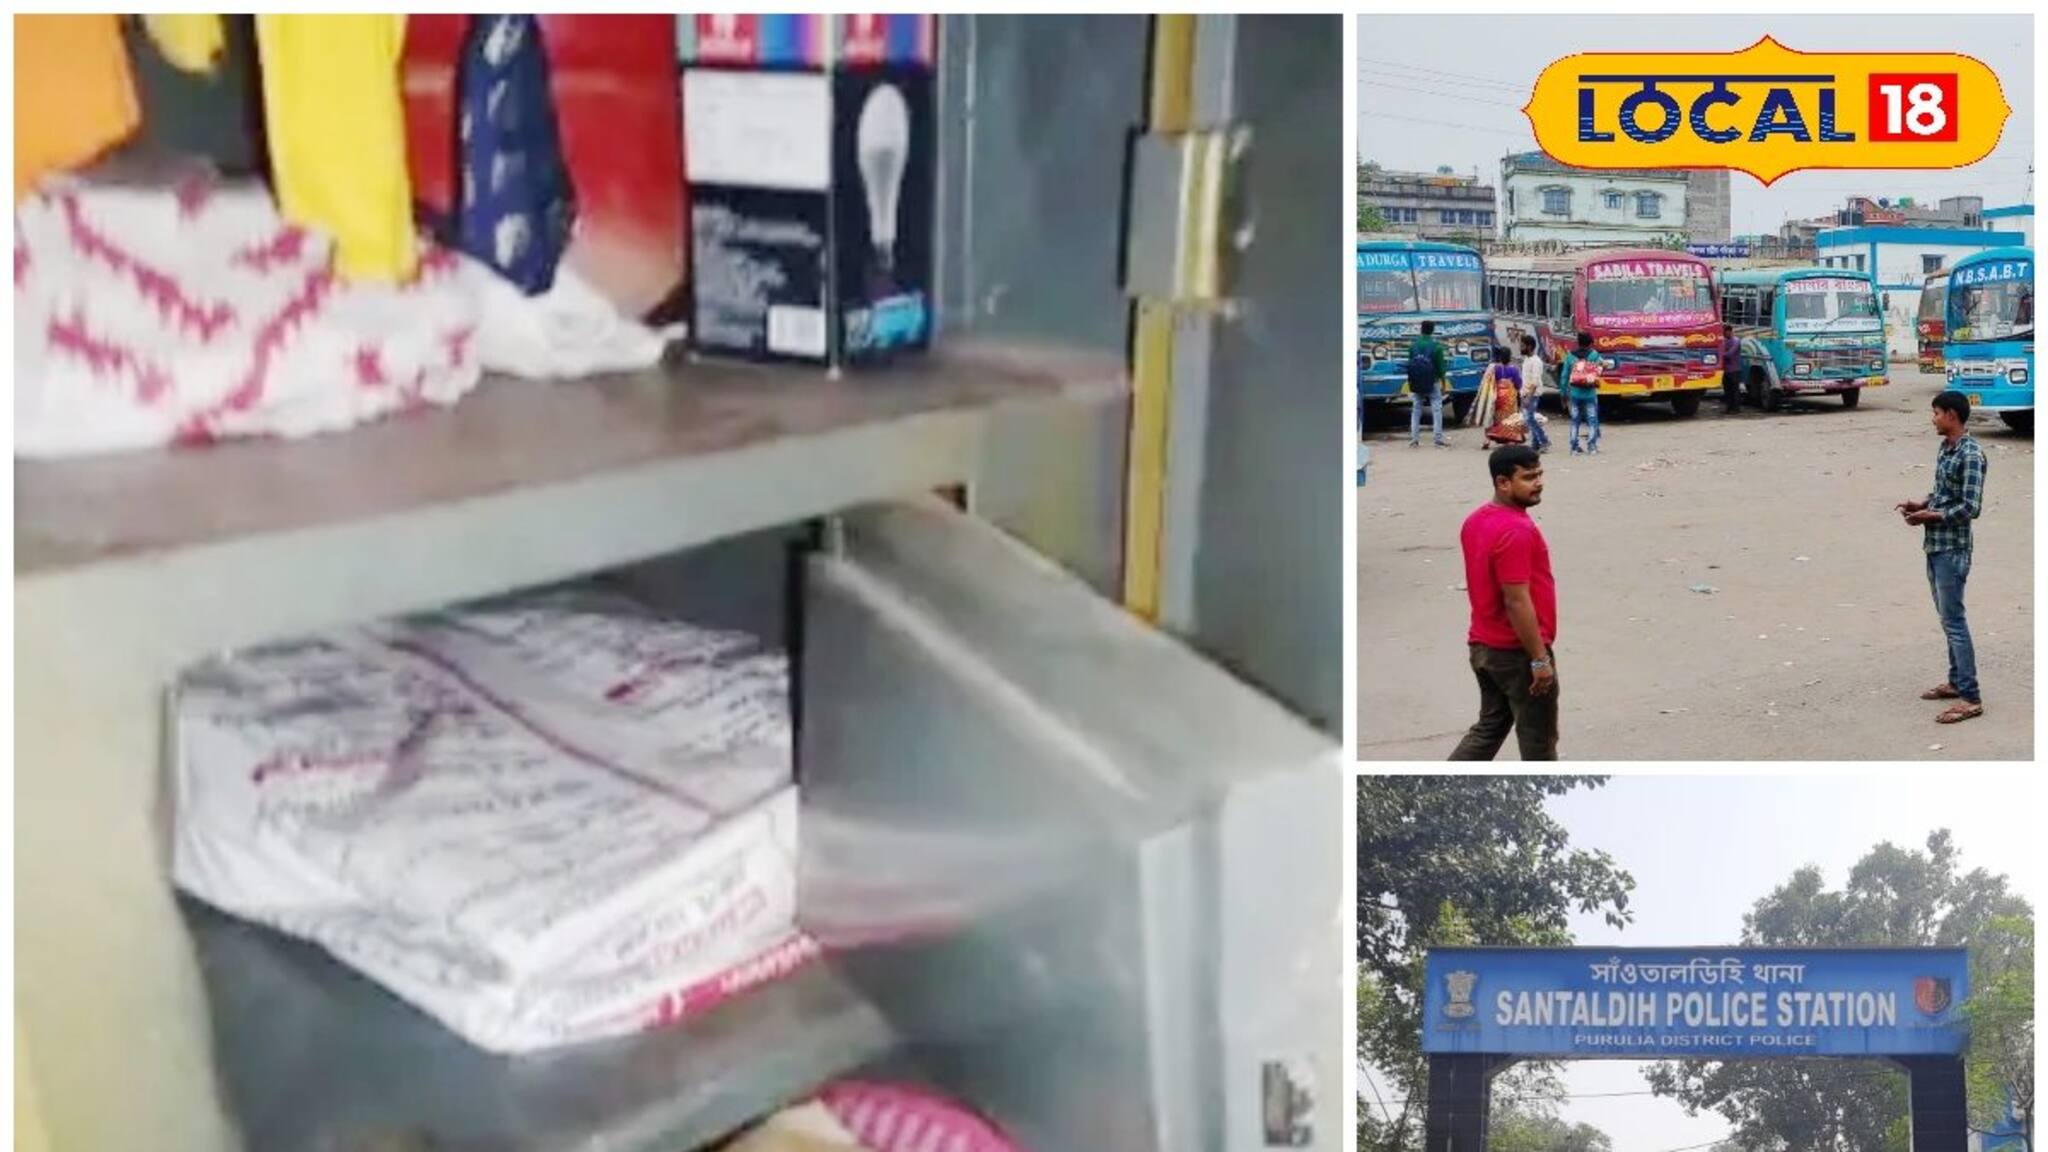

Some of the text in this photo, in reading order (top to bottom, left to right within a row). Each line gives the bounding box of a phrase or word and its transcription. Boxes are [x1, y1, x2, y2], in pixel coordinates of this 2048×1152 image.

[1366, 253, 1408, 267] DURGA
[1417, 254, 1479, 269] TRAVELS
[1593, 262, 1703, 278] SABILA TRAVELS
[1955, 262, 2028, 285] N.B.S.A.B.T
[1589, 956, 1806, 985] সাঁওতালডিহি থানা
[1495, 990, 1897, 1027] SANTALDIH POLICE STATION
[1574, 1034, 1817, 1047] PURULIA DISTRICT POLICE
